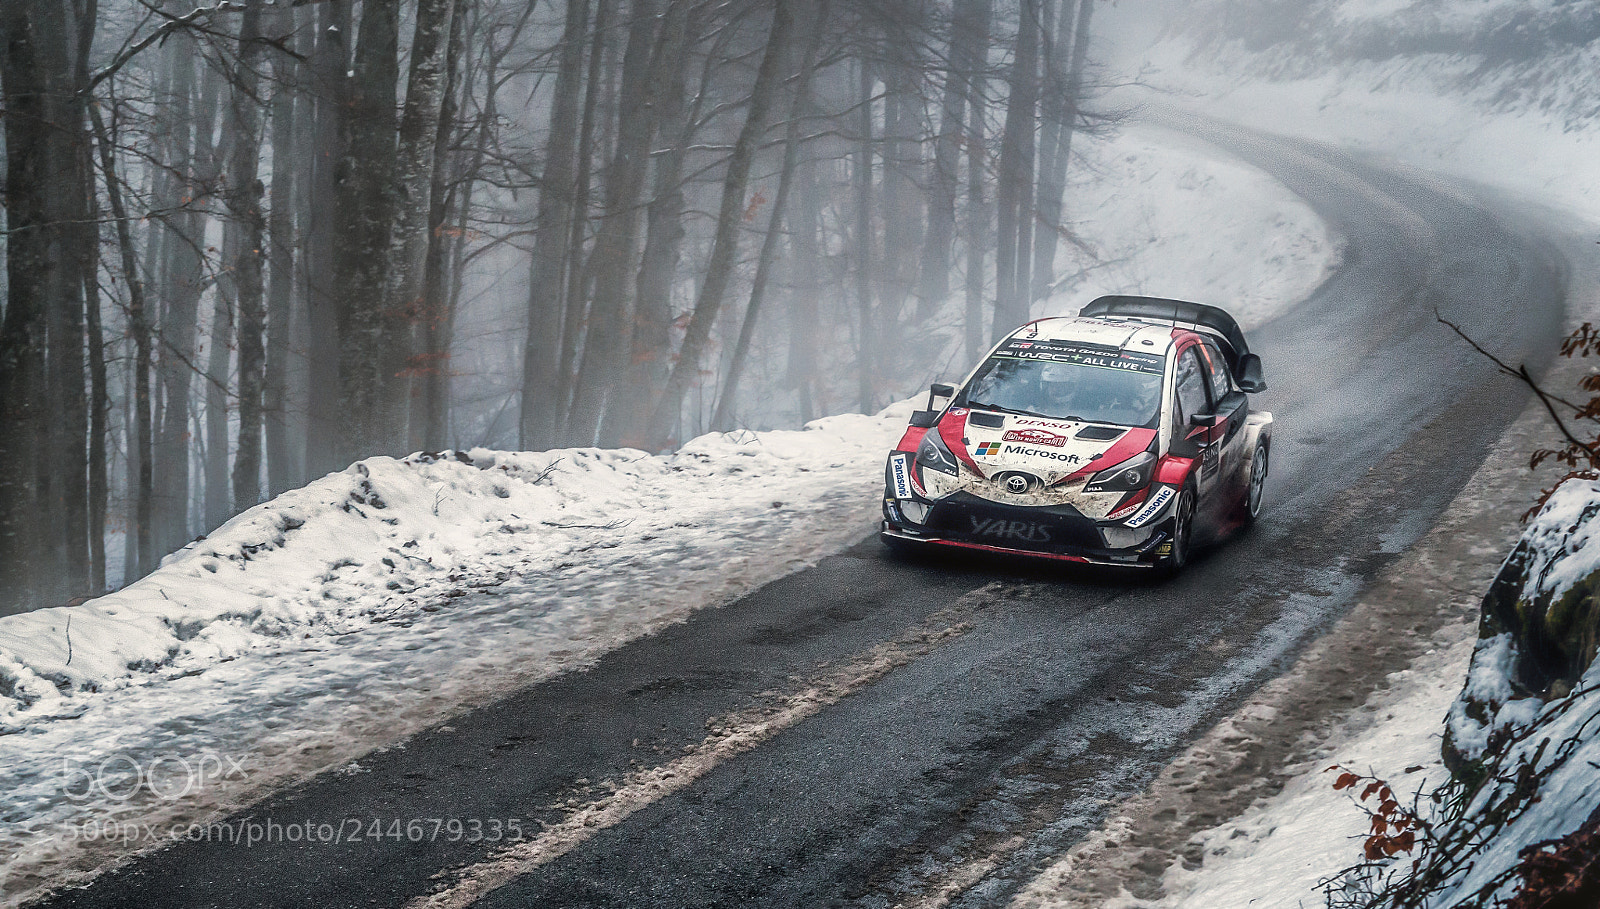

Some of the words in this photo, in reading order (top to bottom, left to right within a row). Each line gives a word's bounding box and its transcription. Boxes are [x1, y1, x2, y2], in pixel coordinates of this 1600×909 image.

[1033, 344, 1076, 353] TOYOTA
[1082, 357, 1107, 366] ALL
[1110, 360, 1139, 370] LIVE
[1015, 419, 1072, 429] DENSO
[1004, 445, 1081, 465] Microsoft
[1128, 489, 1171, 526] Panasonic
